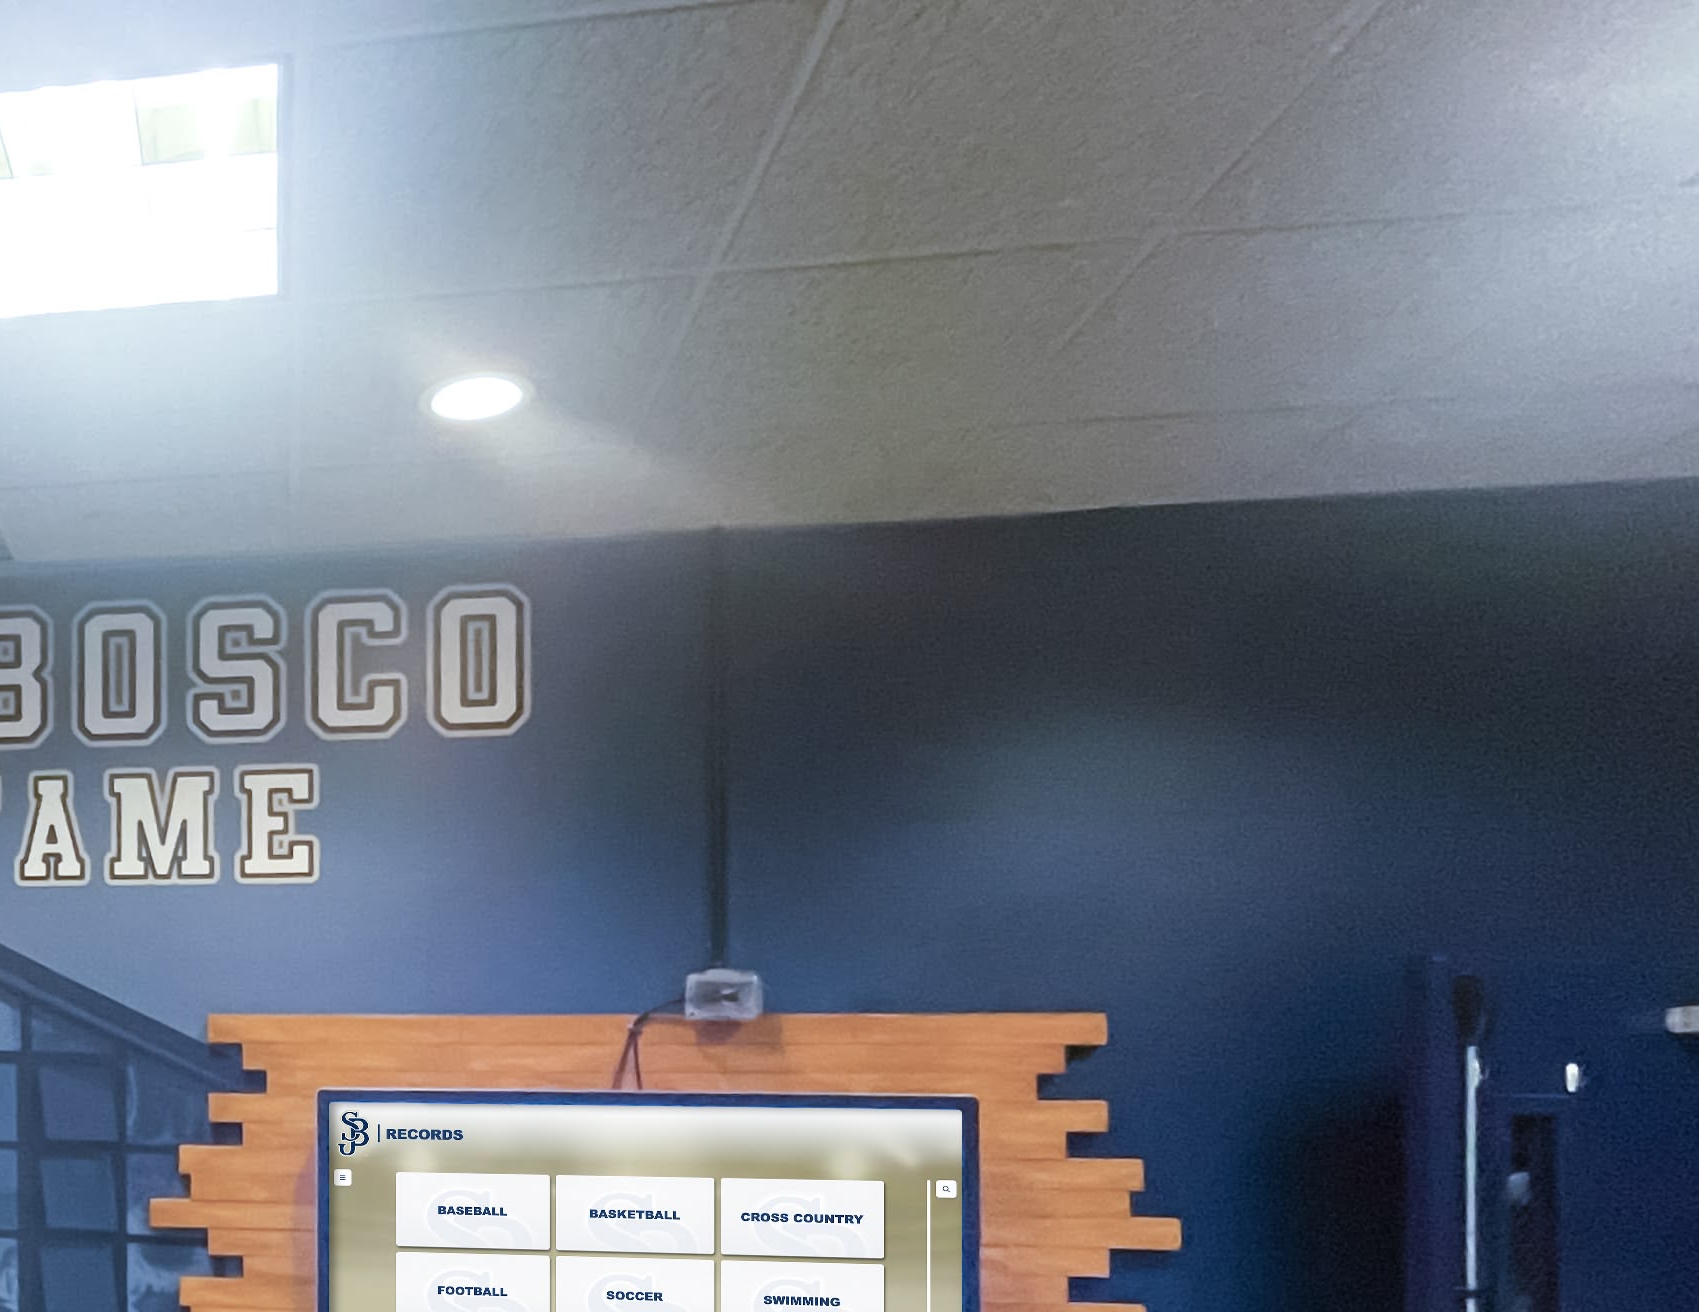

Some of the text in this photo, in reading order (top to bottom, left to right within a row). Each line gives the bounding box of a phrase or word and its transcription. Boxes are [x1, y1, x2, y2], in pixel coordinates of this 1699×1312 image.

[385, 1127, 463, 1140] RECORDS
[437, 1204, 507, 1216] BASEBALL
[589, 1207, 680, 1220] BASKETBALL
[740, 1211, 863, 1224] CROSS COUNTRY
[437, 1284, 507, 1297] FOOTBALL
[606, 1289, 663, 1301] SOCCER
[763, 1294, 840, 1306] SWIMMING
